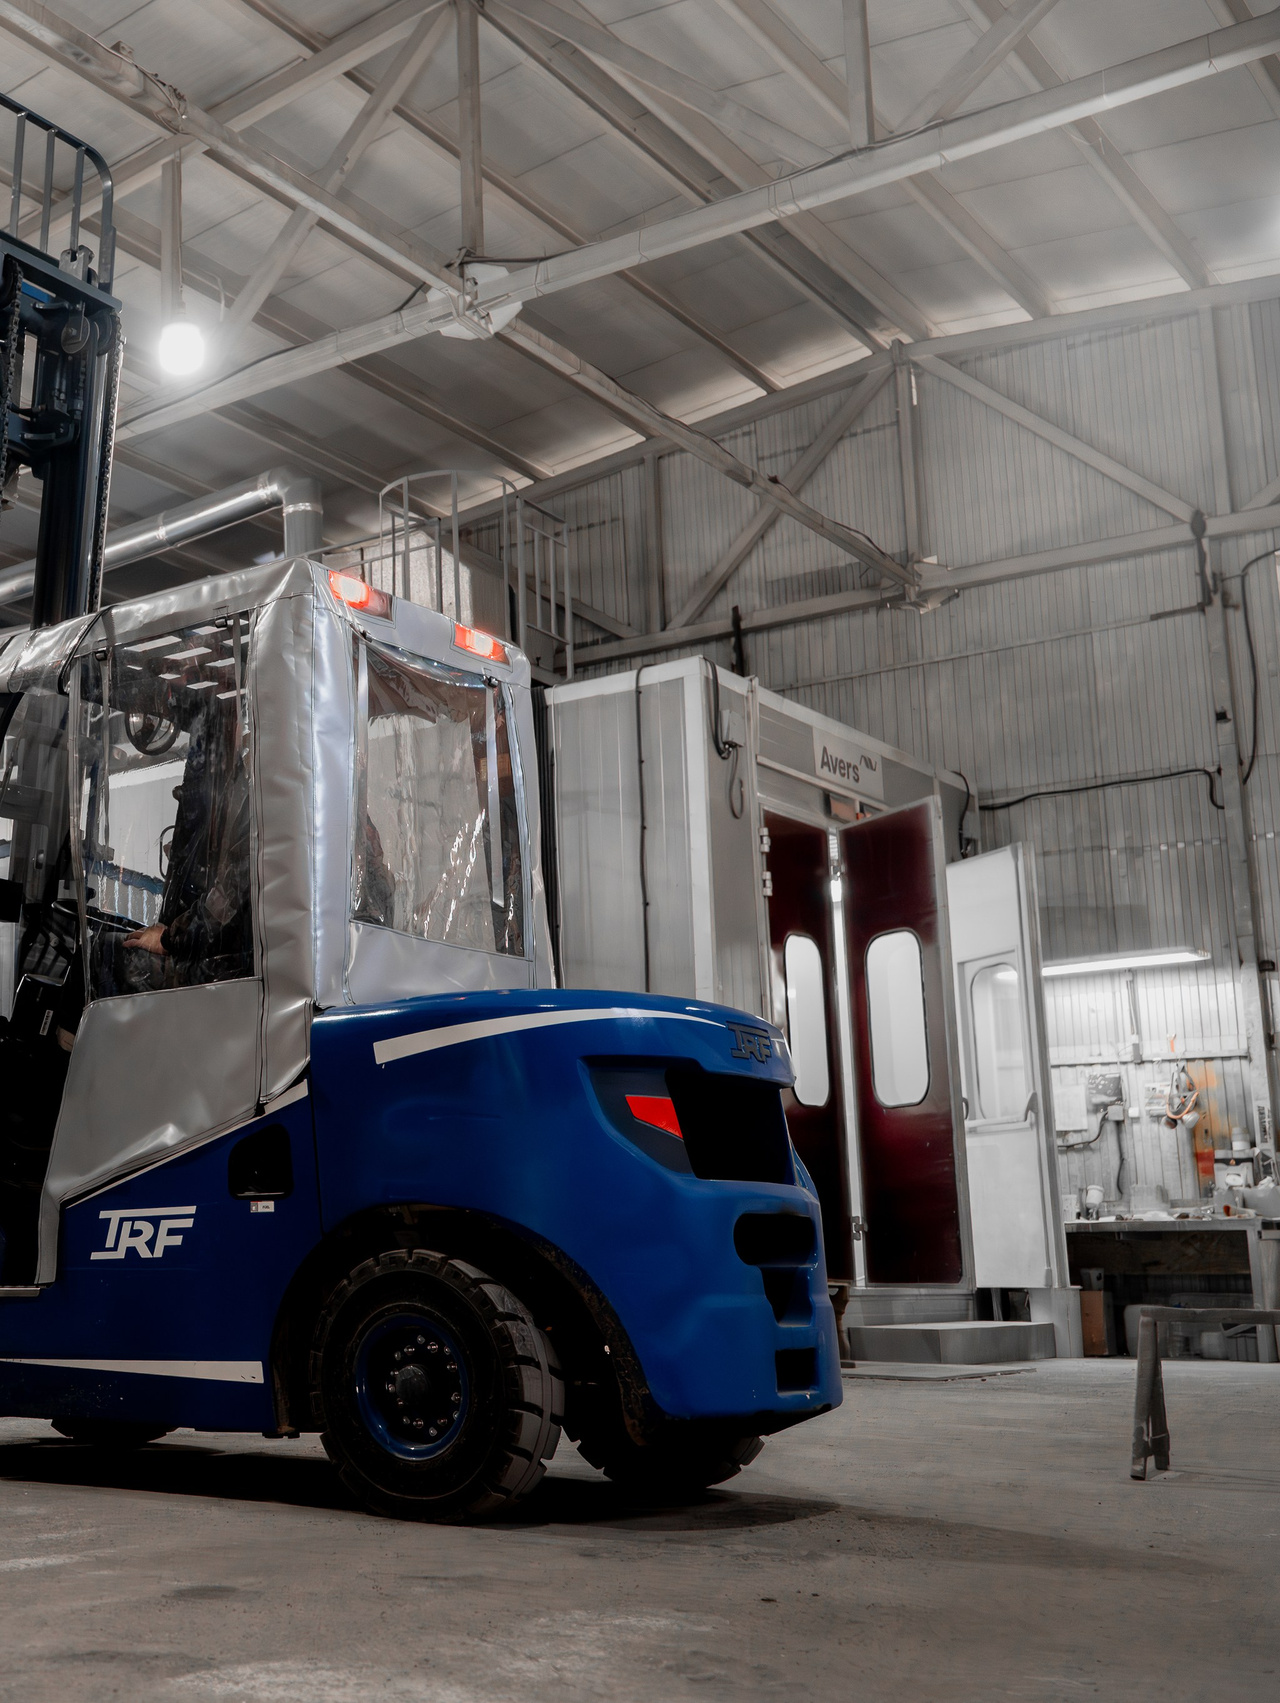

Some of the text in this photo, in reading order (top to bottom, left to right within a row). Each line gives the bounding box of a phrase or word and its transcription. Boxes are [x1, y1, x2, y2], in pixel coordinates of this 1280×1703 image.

[820, 745, 860, 783] Avers
[726, 1021, 772, 1064] TRF
[90, 1205, 197, 1260] TRF
